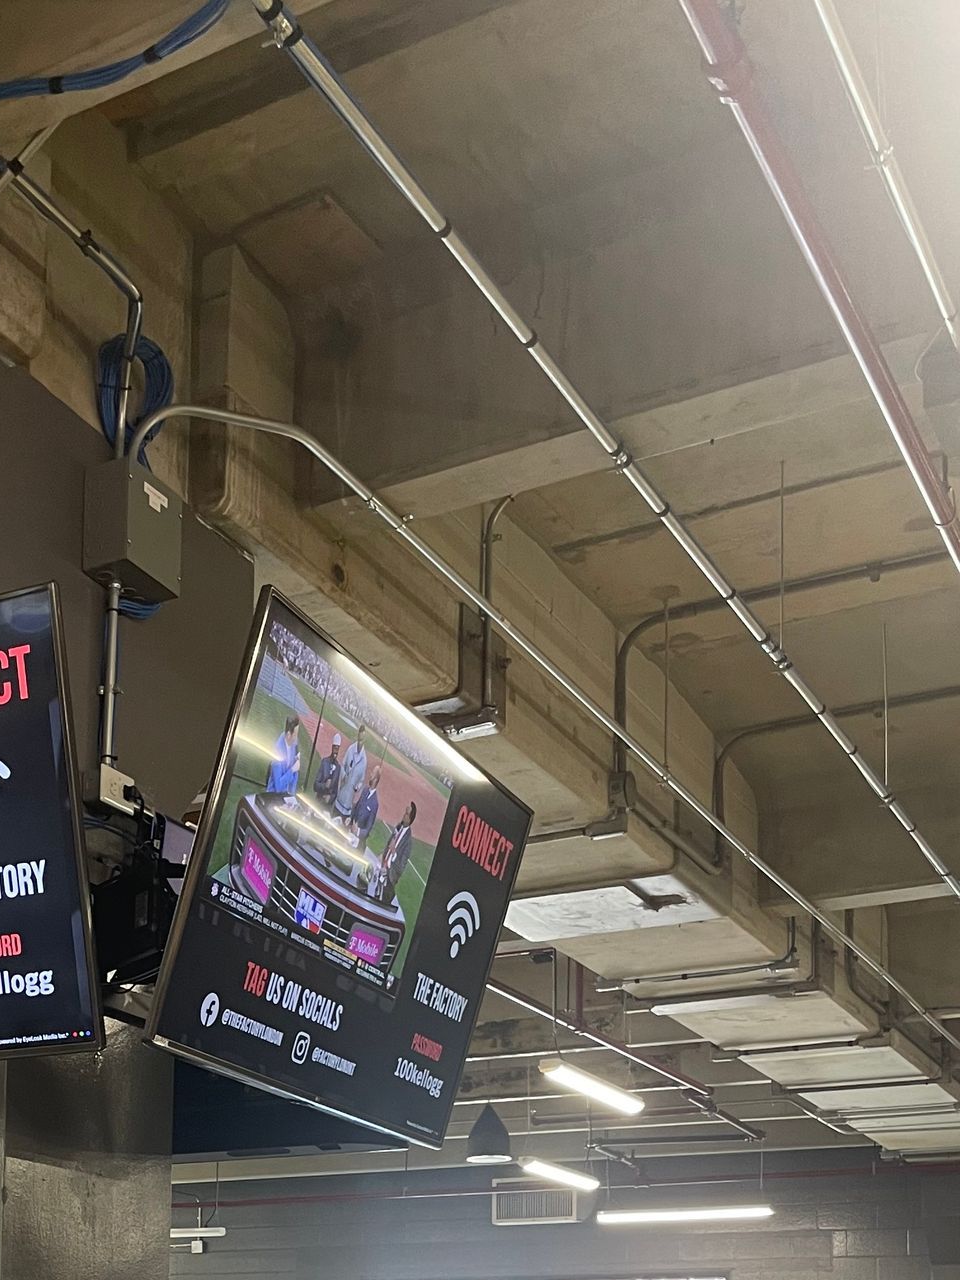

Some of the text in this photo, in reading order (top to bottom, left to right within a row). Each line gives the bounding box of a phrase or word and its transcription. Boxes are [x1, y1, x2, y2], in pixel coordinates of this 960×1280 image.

[452, 805, 514, 880] CONNECT
[243, 961, 343, 1032] TAG US ON SOCIALS
[413, 972, 434, 1007] THE
[429, 982, 468, 1023] FACTORY
[394, 1057, 444, 1098] 100kellogg
